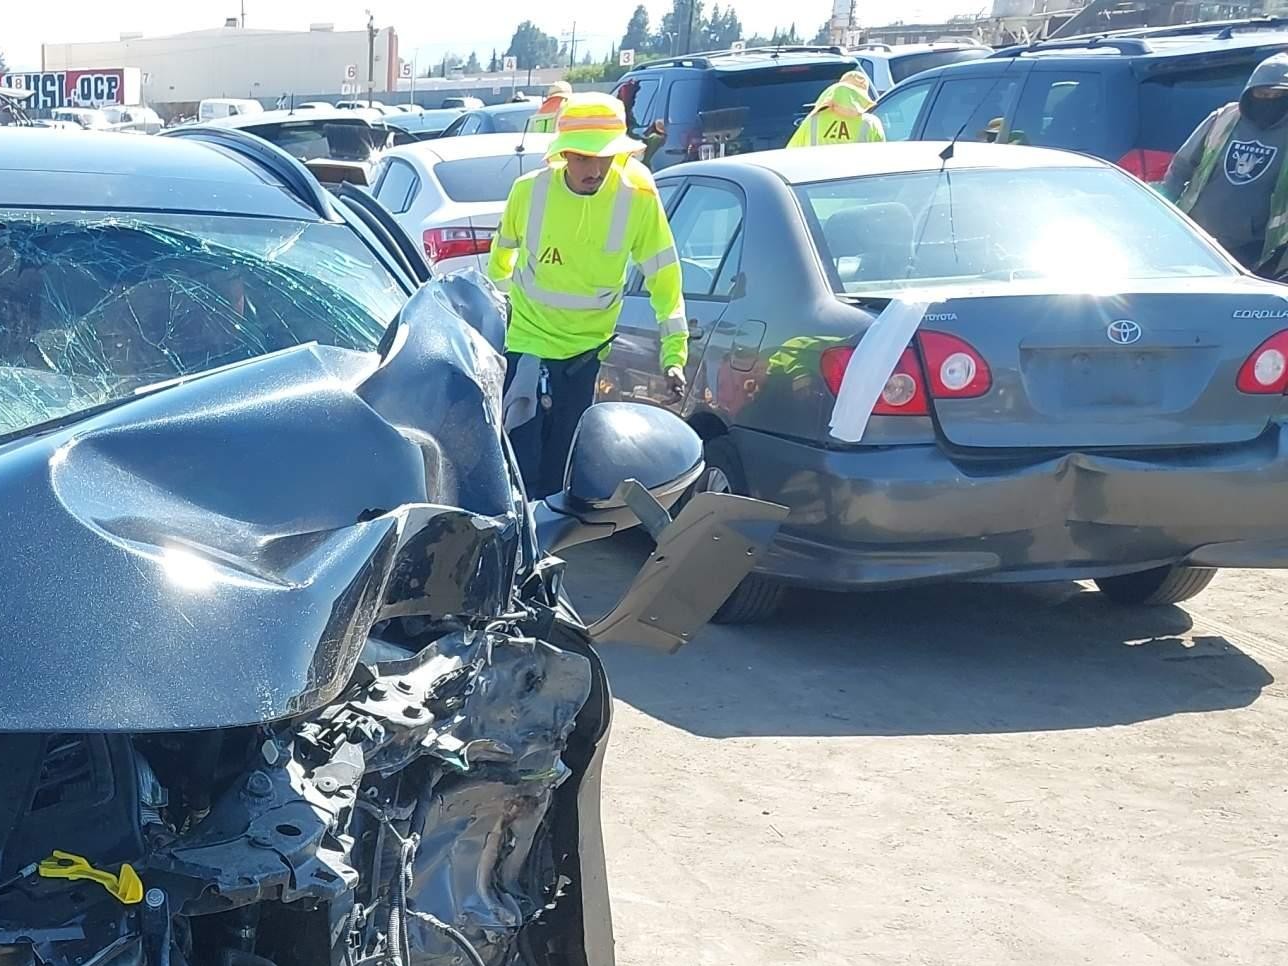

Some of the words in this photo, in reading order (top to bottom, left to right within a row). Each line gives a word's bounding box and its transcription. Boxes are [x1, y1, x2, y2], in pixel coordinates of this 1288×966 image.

[623, 53, 631, 63] 3
[402, 64, 411, 75] 5
[505, 59, 514, 70] 4
[347, 66, 355, 77] 6
[15, 79, 22, 89] 8
[1234, 143, 1271, 156] RAIDERS
[924, 313, 958, 321] TOYOTA
